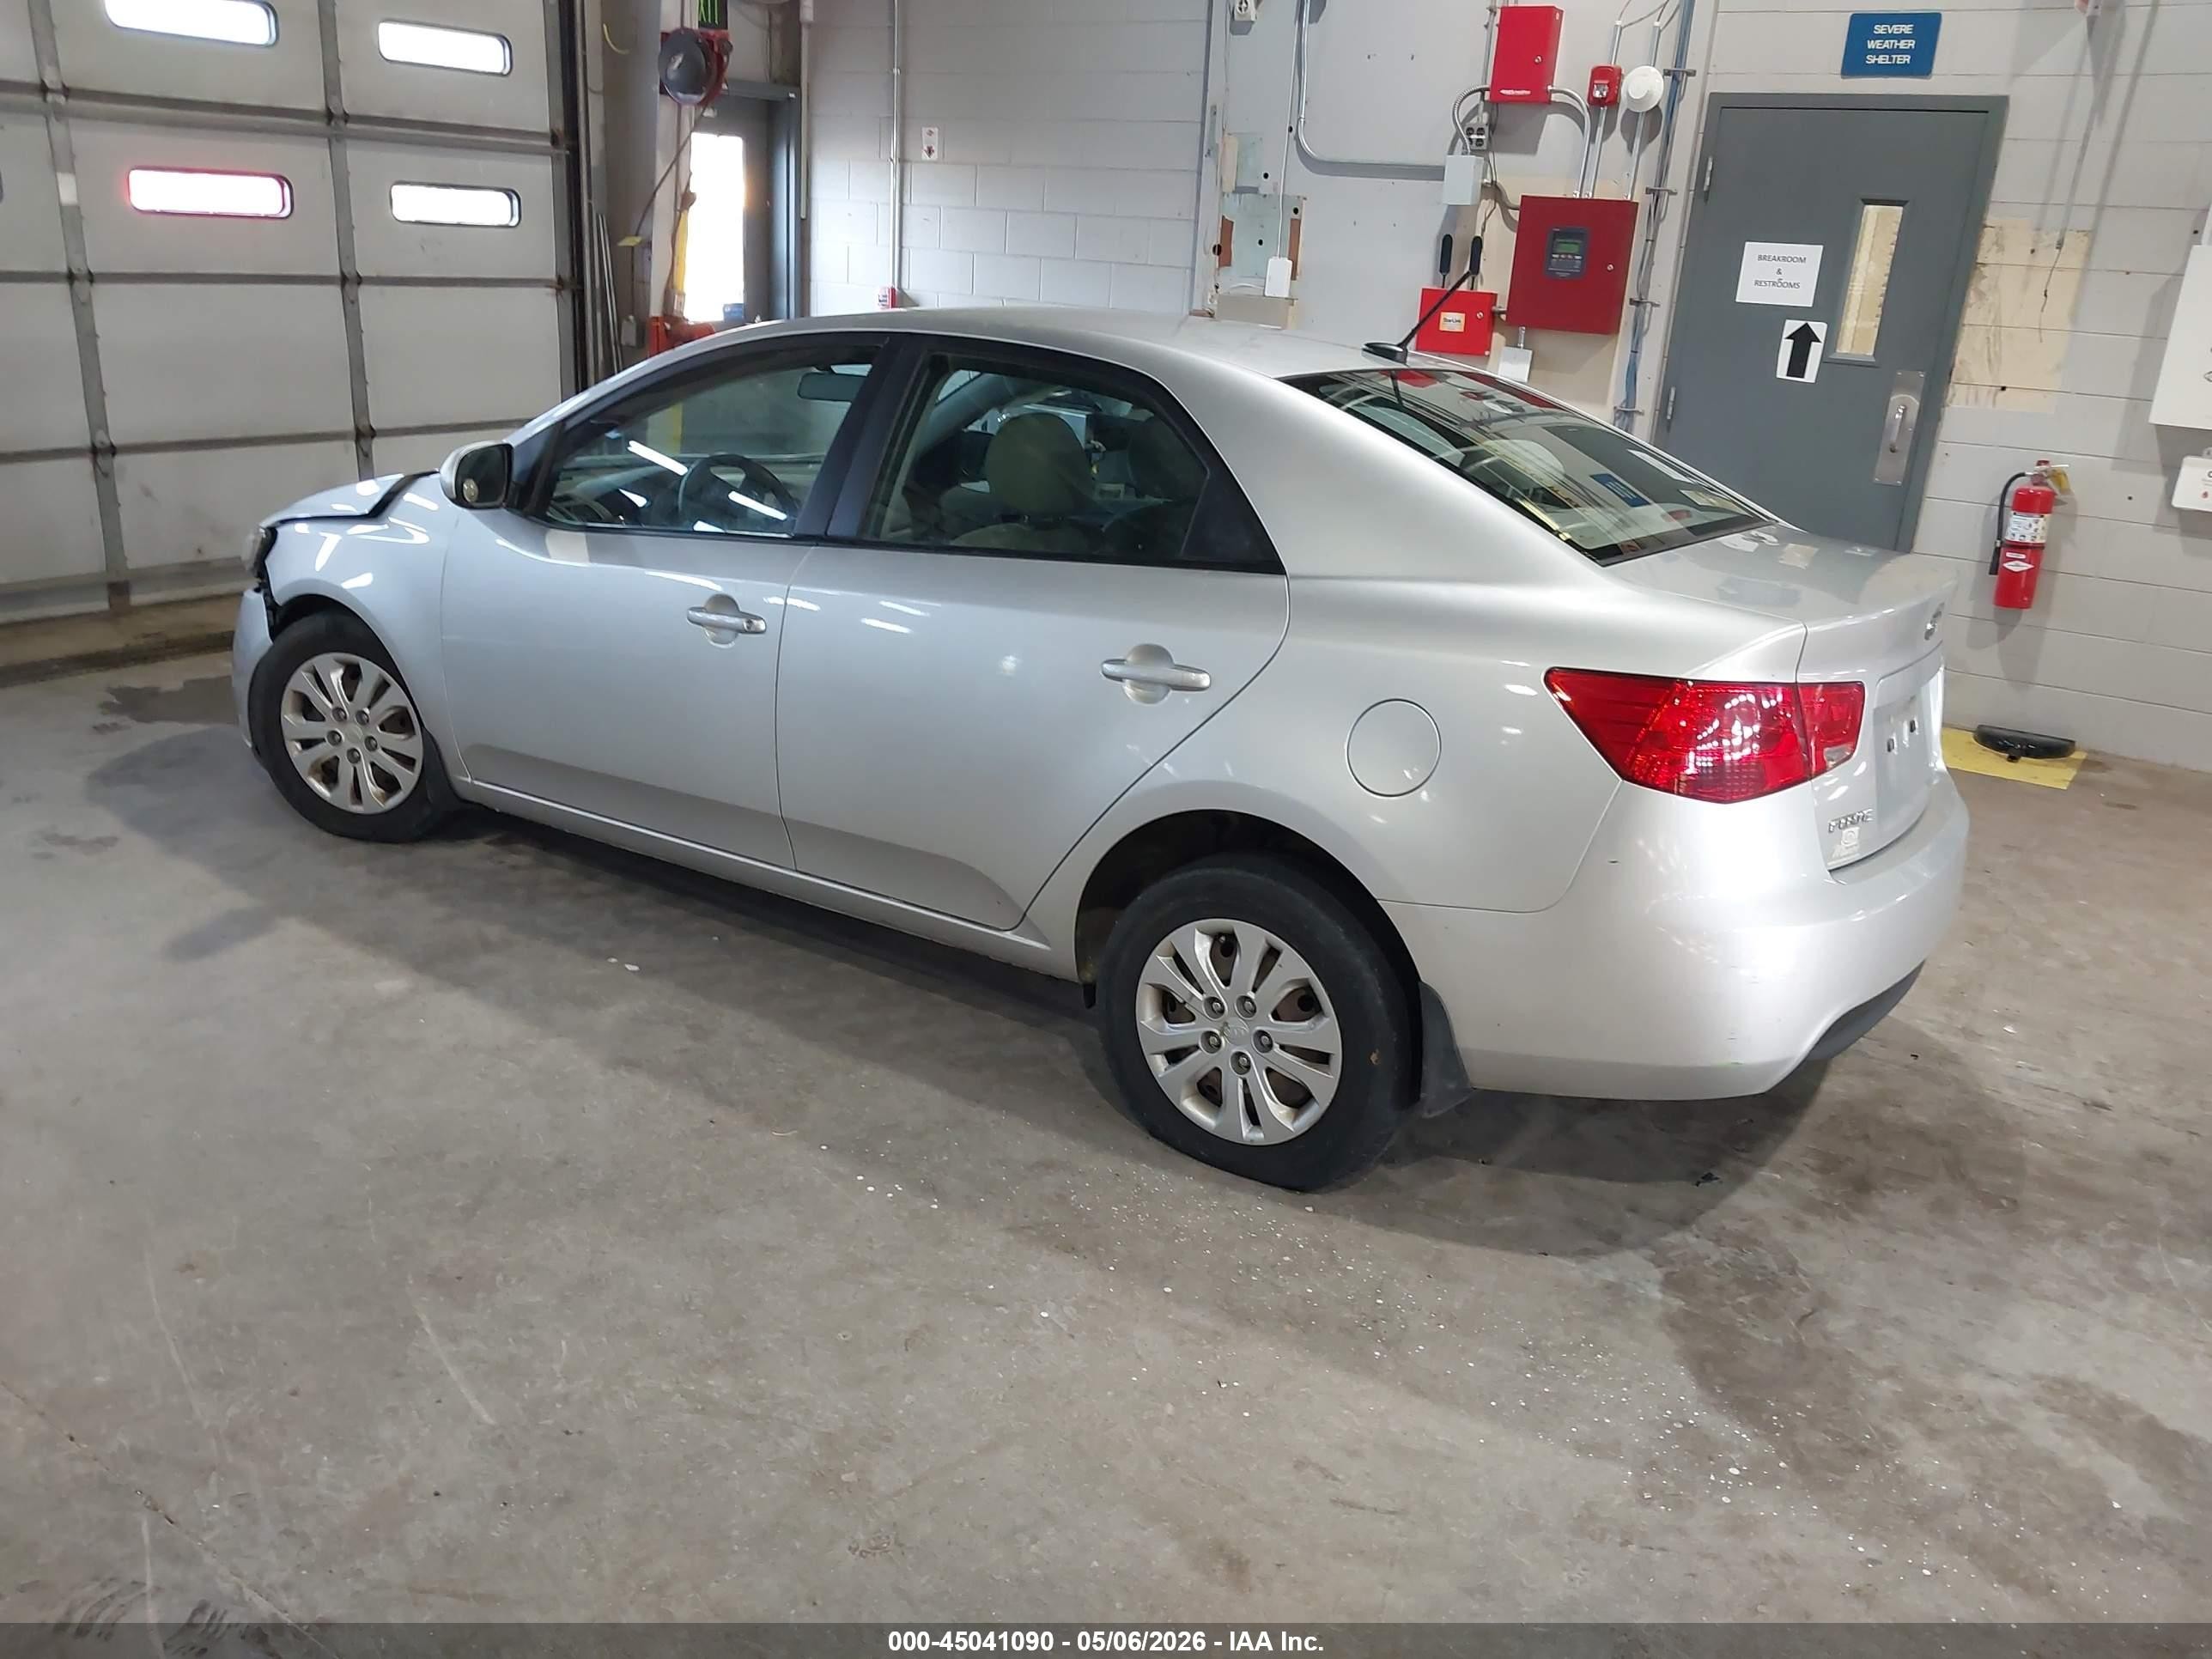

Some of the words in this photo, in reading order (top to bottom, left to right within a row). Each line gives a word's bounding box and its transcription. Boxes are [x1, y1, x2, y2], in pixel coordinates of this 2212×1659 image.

[1873, 24, 1914, 34] SEVERE
[1867, 40, 1916, 49] WEATHER
[1865, 54, 1911, 64] SHELTER
[1758, 254, 1807, 264] BREAKROOM
[1753, 279, 1801, 289] RESTROOMS
